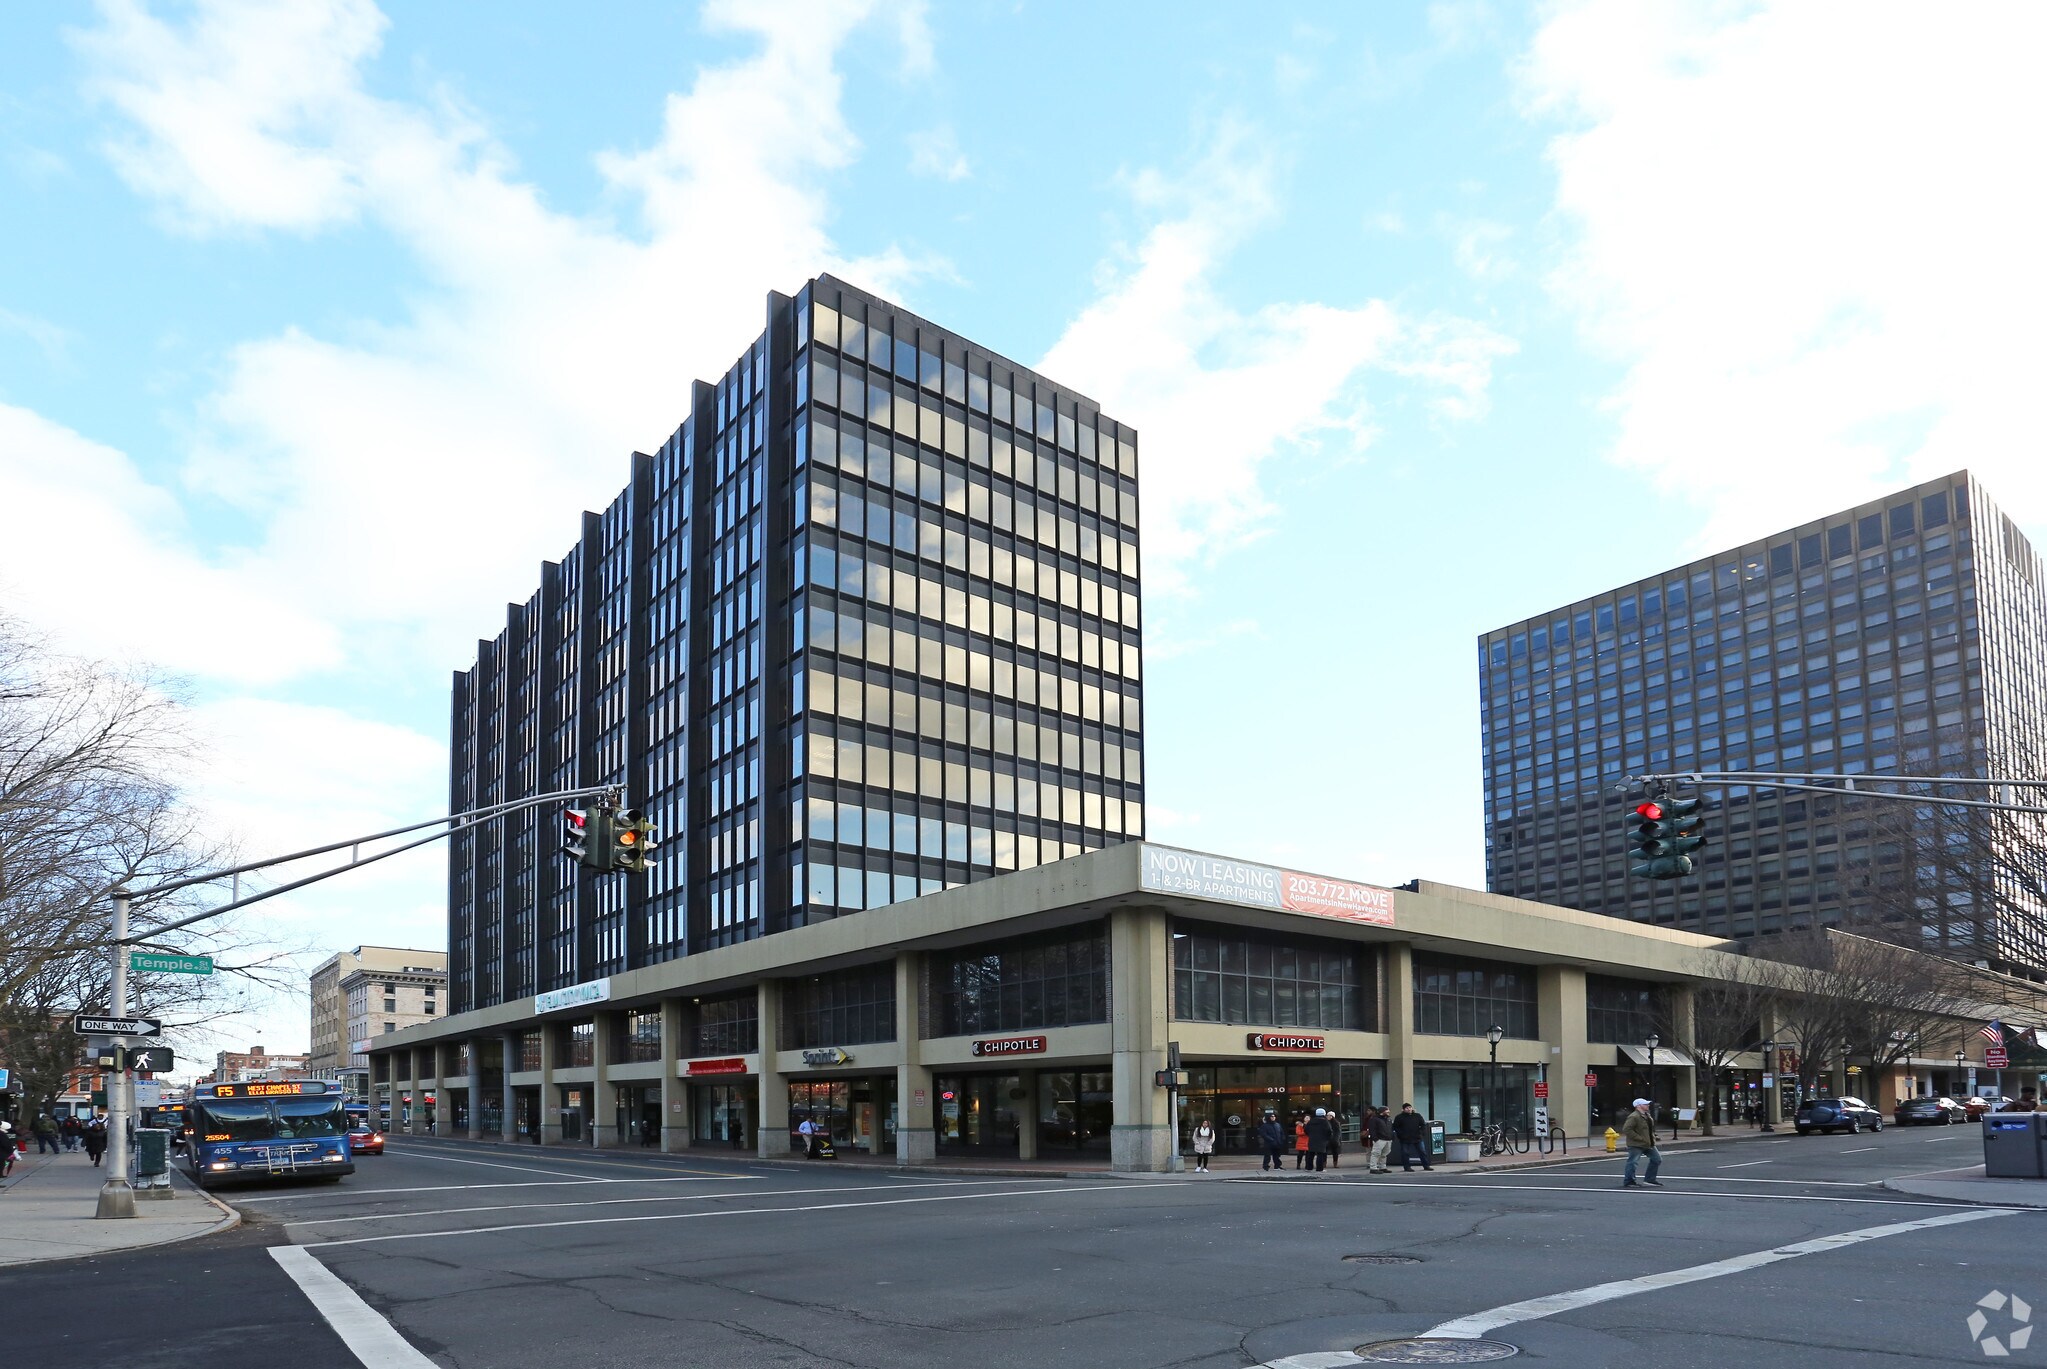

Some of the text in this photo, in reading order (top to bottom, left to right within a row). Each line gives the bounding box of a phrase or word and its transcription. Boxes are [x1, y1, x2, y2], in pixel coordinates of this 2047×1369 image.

[1150, 851, 1274, 889] NOW LEASING
[1164, 875, 1172, 887] &
[1174, 877, 1201, 891] 2-BR
[1204, 882, 1274, 902] APARTMENTS
[1289, 877, 1388, 908] 203.772.MOVE
[133, 956, 194, 971] Temple
[84, 1021, 136, 1031] ONE WAY
[984, 1039, 1039, 1052] CHIPOTLE
[1269, 1037, 1325, 1049] CHIPOTLE
[802, 1049, 836, 1067] Sprint
[217, 1086, 234, 1097] F5
[213, 1147, 232, 1155] 455
